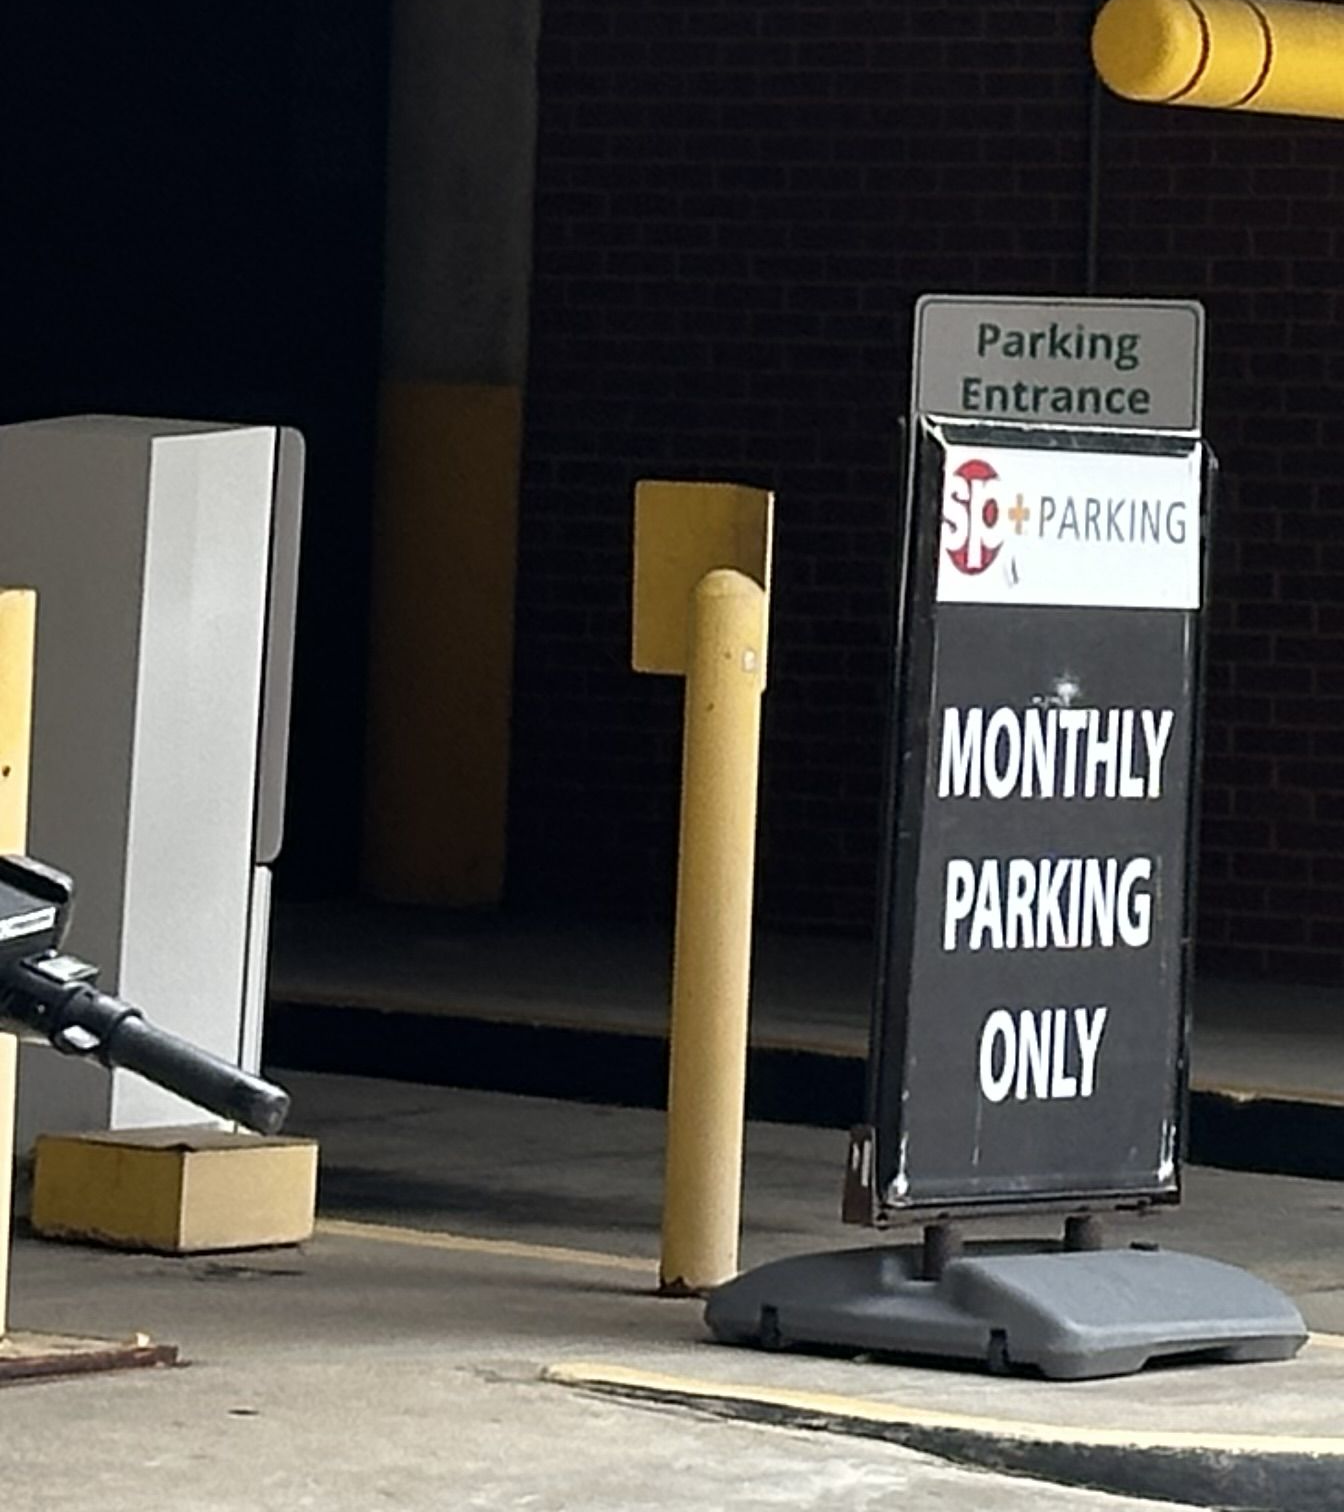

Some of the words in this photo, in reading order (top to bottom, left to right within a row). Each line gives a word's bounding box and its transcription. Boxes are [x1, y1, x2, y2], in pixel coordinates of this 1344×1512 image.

[977, 322, 1142, 371] Parking
[961, 377, 1151, 414] Entrance
[1038, 495, 1187, 545] PARKING
[937, 707, 1174, 798] MONTHLY
[943, 857, 1153, 951] PARKING
[978, 1006, 1108, 1102] ONLY
